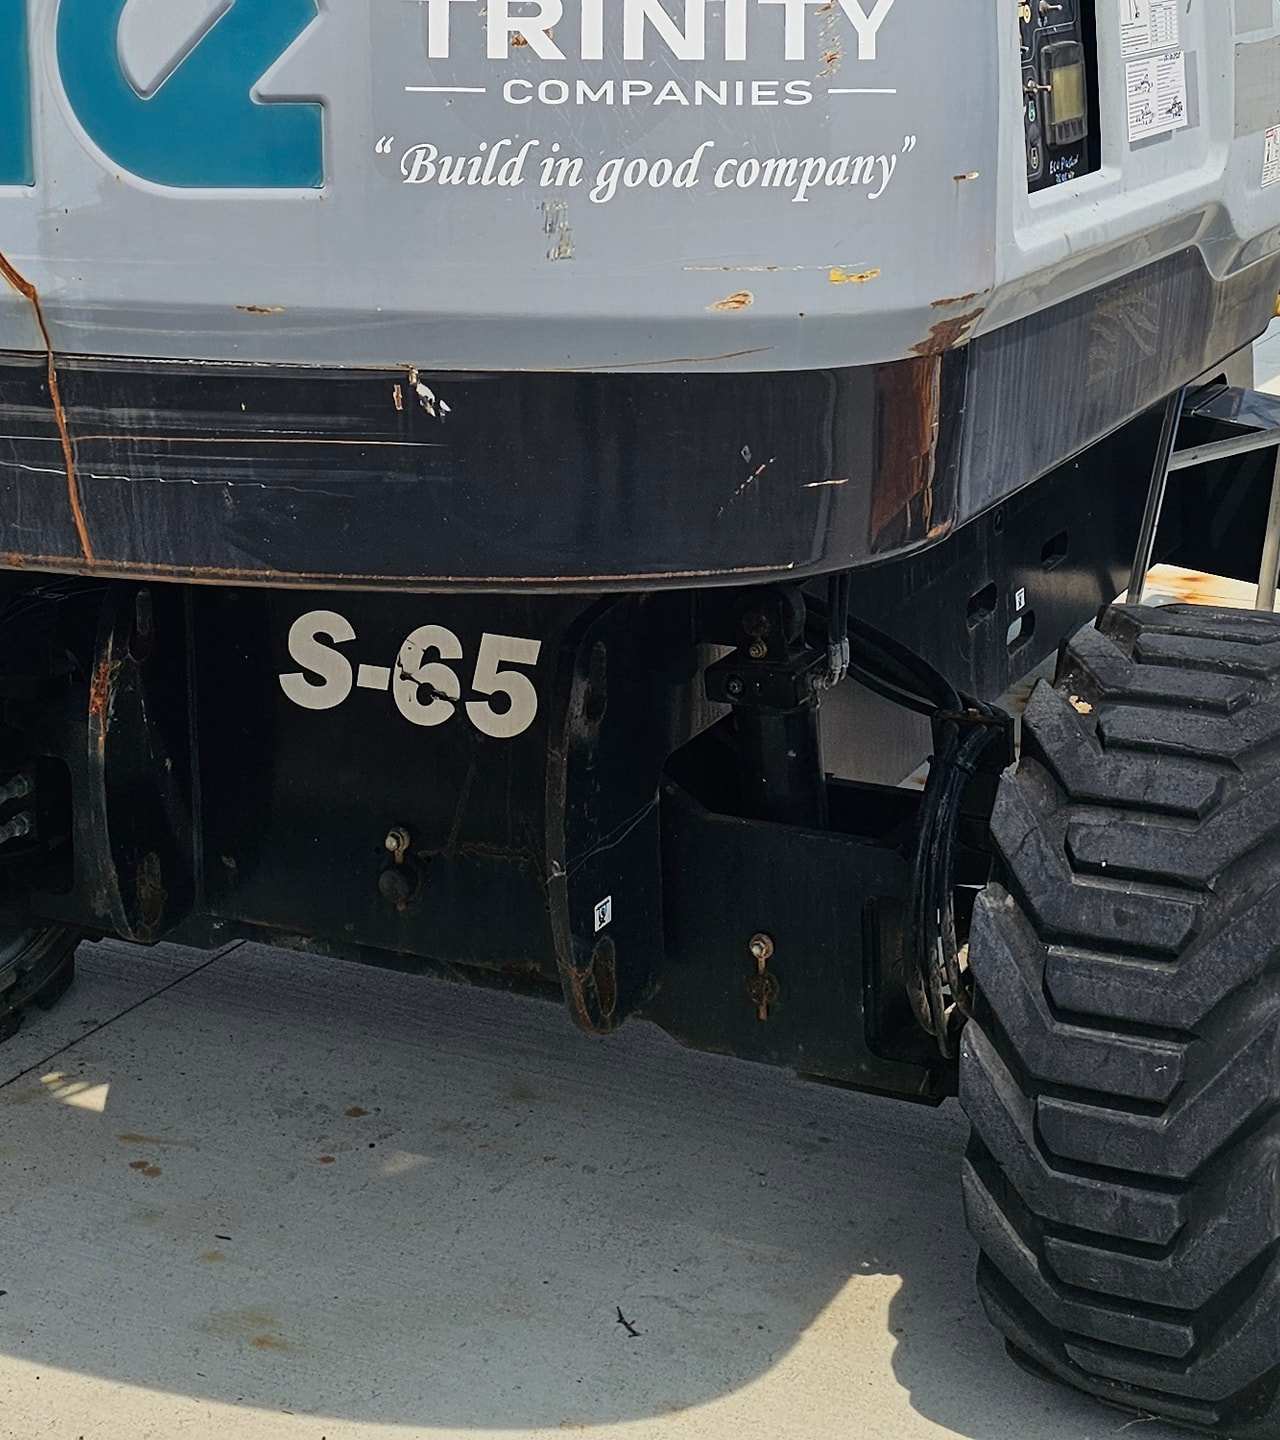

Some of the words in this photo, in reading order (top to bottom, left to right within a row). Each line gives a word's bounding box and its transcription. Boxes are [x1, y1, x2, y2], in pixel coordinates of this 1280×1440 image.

[502, 78, 813, 106] COMPANIES
[539, 142, 583, 187] in
[589, 141, 714, 203] good
[278, 610, 542, 738] S-65
